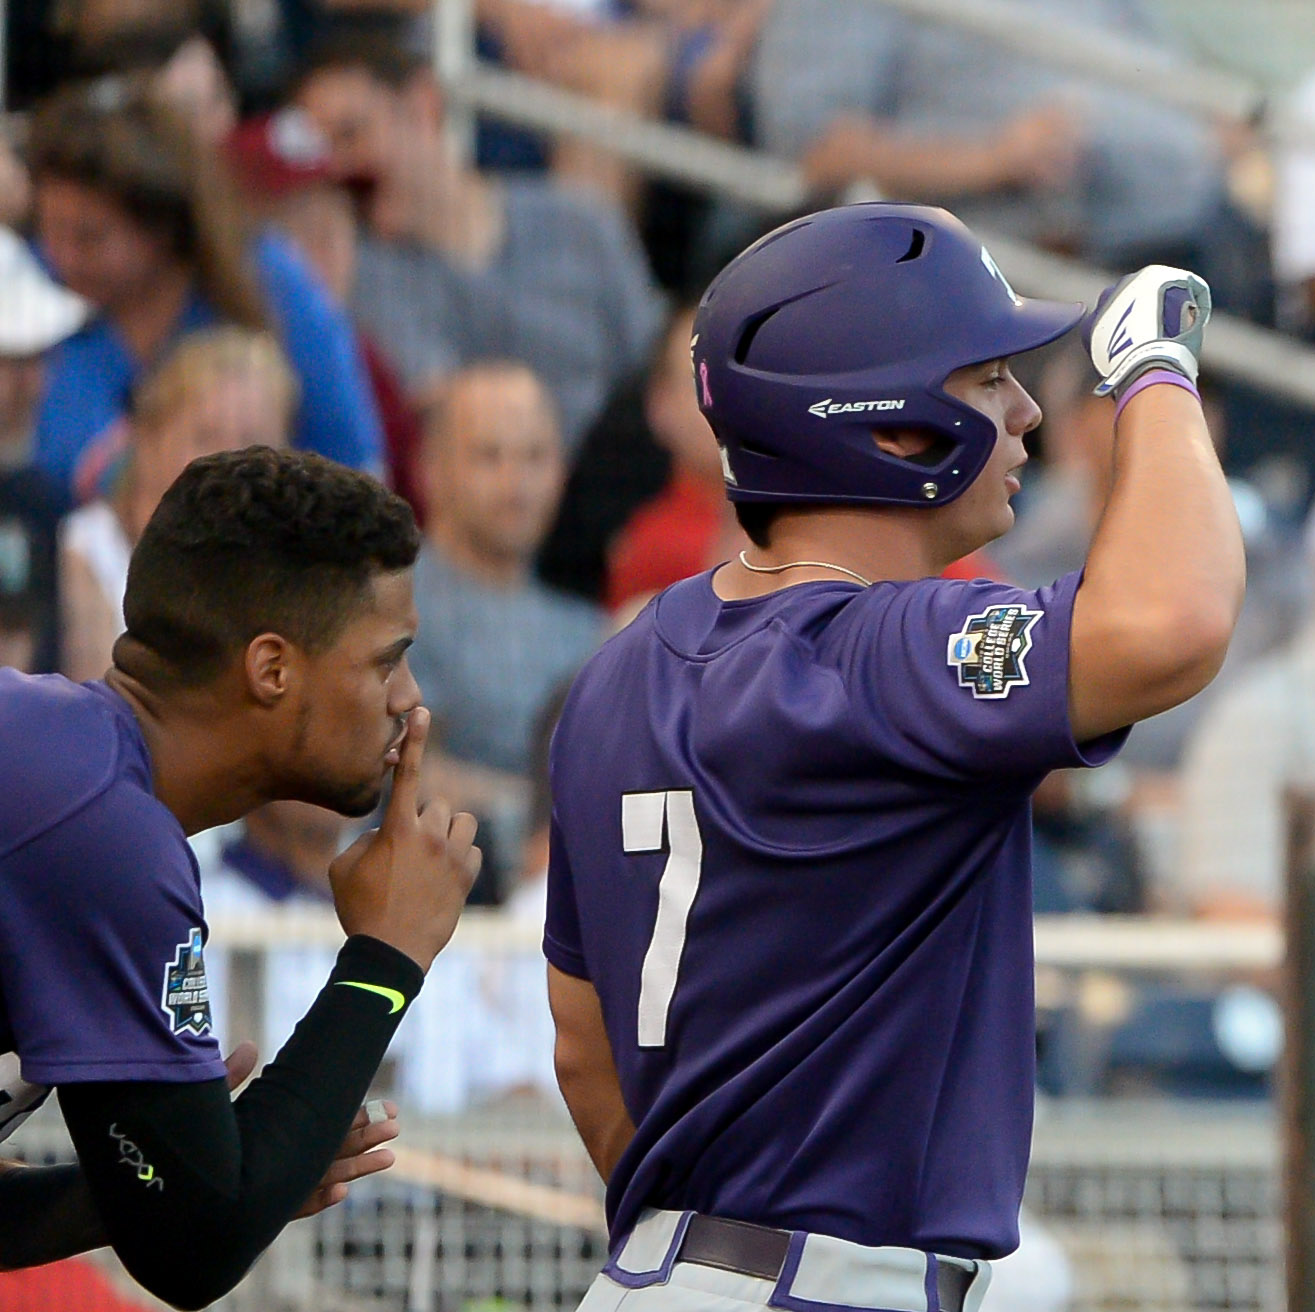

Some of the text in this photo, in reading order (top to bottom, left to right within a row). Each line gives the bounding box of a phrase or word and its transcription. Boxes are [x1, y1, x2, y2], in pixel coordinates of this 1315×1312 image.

[827, 399, 905, 414] EASTON
[983, 623, 1001, 673] COLLEGE
[993, 646, 1005, 691] WORLD
[621, 788, 704, 1049] 7
